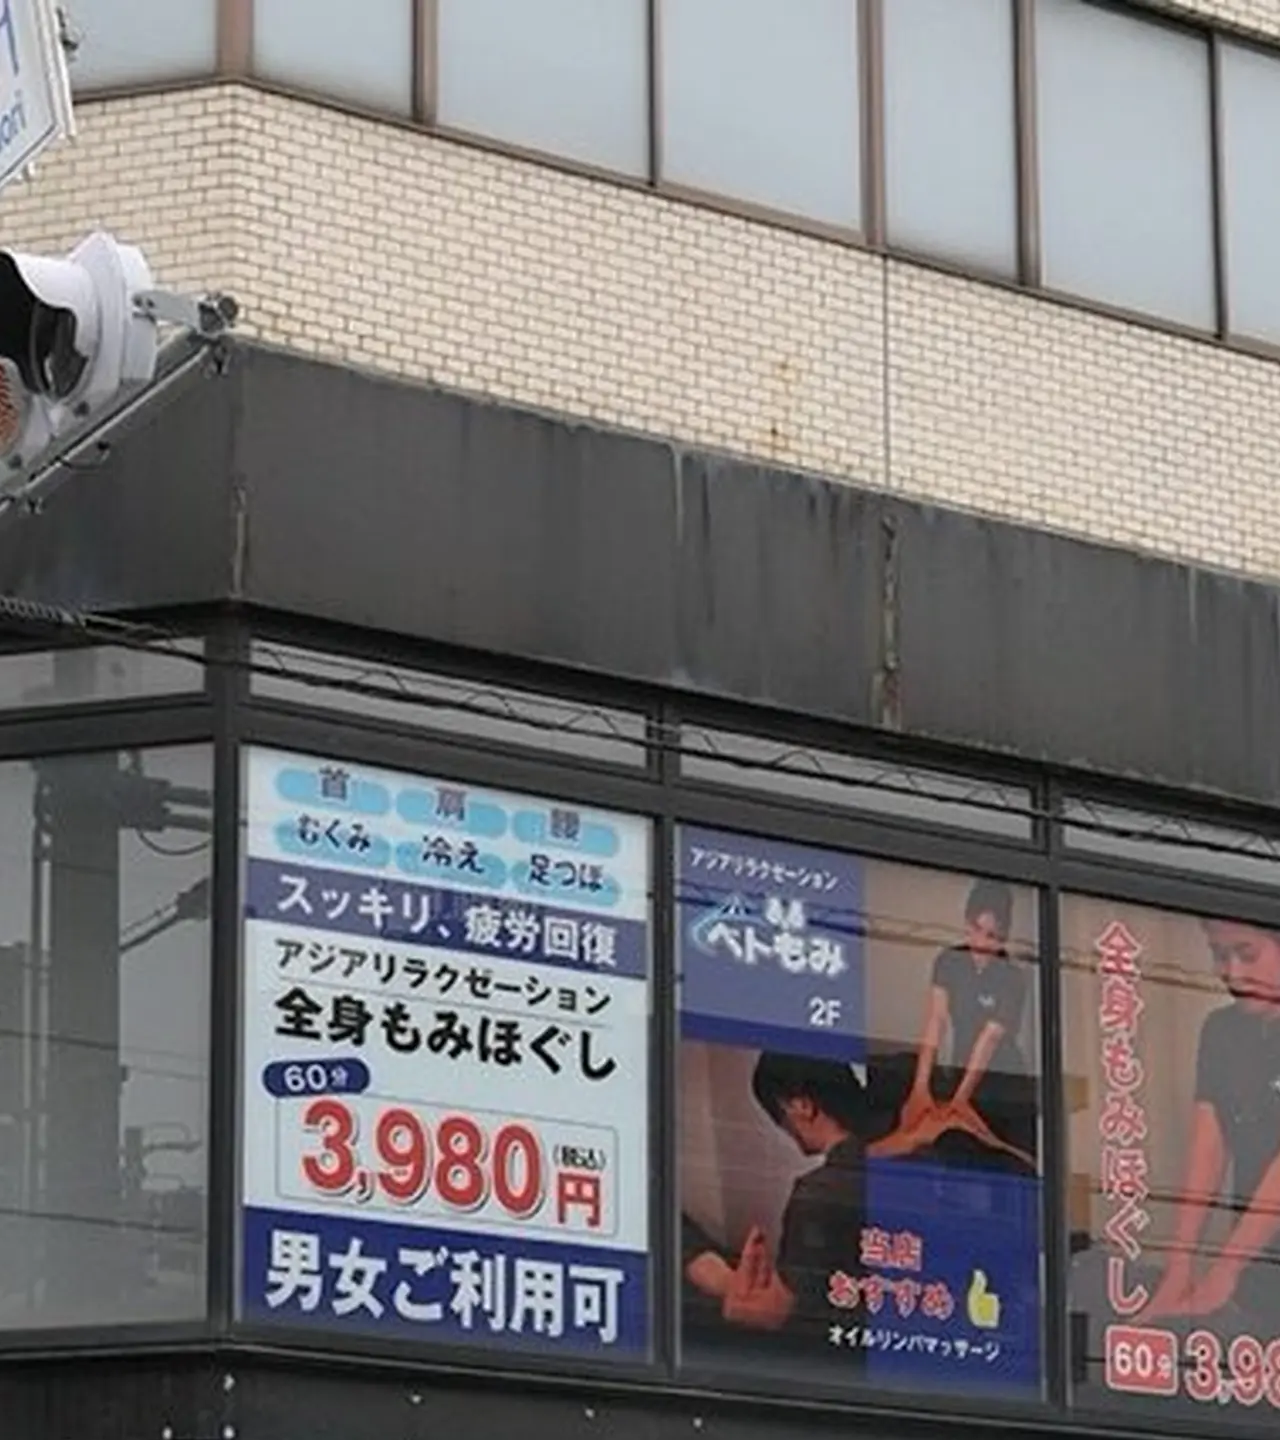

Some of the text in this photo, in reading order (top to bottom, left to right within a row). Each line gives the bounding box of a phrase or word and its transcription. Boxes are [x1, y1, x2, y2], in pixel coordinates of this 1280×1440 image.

[320, 768, 349, 800] 首
[298, 814, 371, 851] むくみ
[423, 835, 484, 874] 冷え
[278, 874, 618, 966] スッキリ、疲労回復
[275, 939, 611, 1015] アジアリラクゼーション
[274, 988, 616, 1081] 全身もみほぐし
[809, 996, 842, 1027] 2F
[284, 1064, 348, 1094] 60分
[1098, 921, 1149, 1315] 全身もみほぐし
[264, 1229, 625, 1343] 男女ご利用可
[827, 1270, 955, 1320] おすすめ
